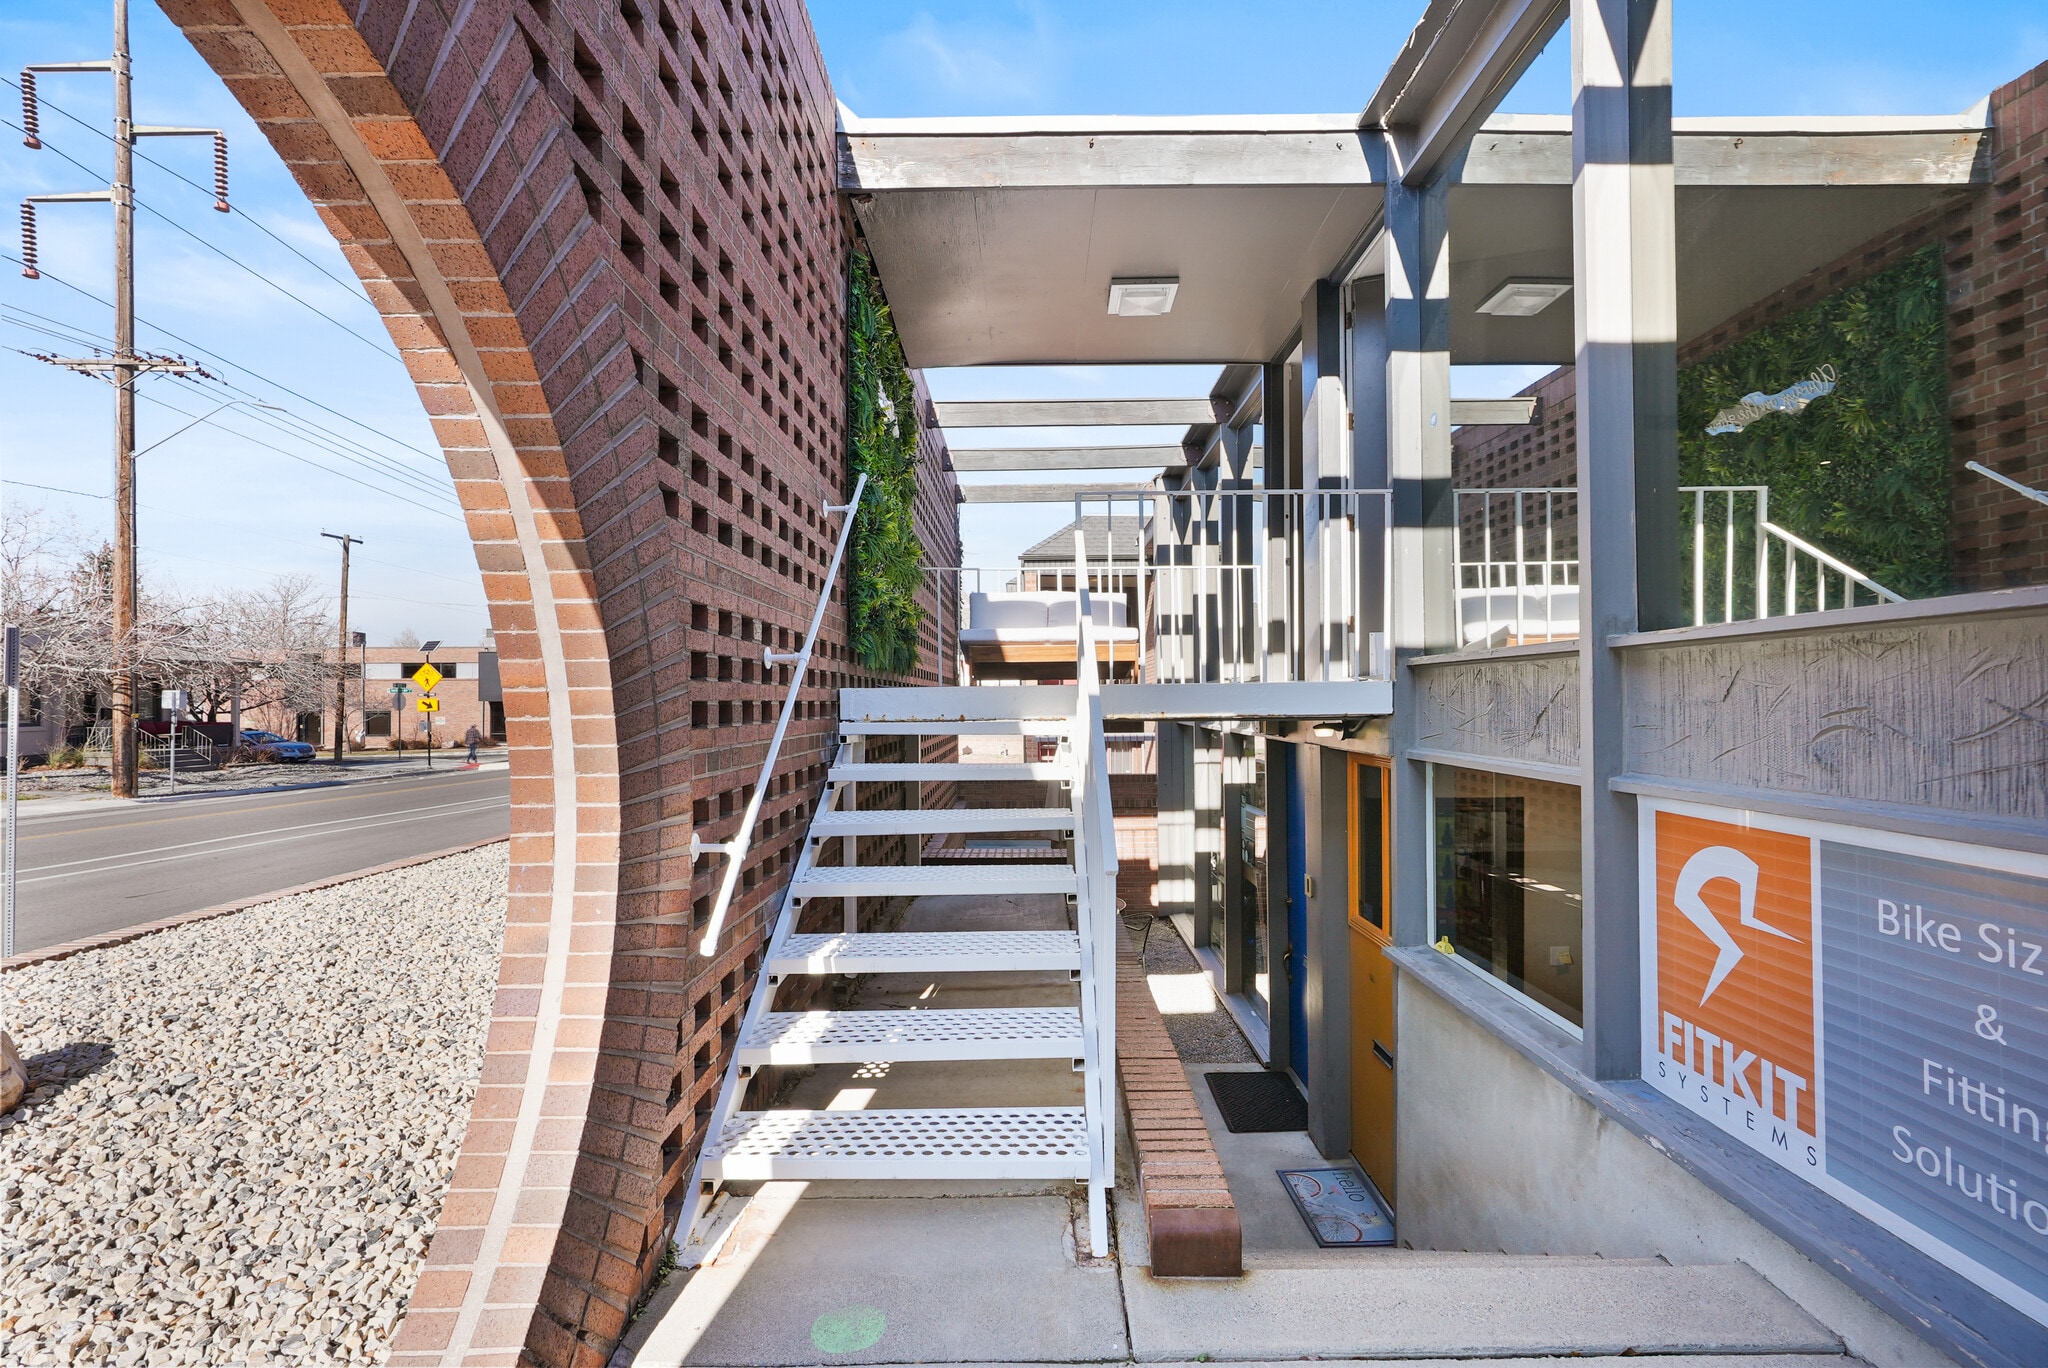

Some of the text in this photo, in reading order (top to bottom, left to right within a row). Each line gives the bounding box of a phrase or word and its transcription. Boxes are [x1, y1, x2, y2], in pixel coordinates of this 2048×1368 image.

[1877, 898, 2045, 976] Bike Siz
[1663, 1010, 1807, 1130] FITKIT
[1974, 1003, 2008, 1046] &
[1658, 1061, 1818, 1167] SYSTEMS
[1922, 1057, 2048, 1155] Fittin
[1332, 1171, 1366, 1202] hello
[1891, 1124, 2048, 1236] Solutio
